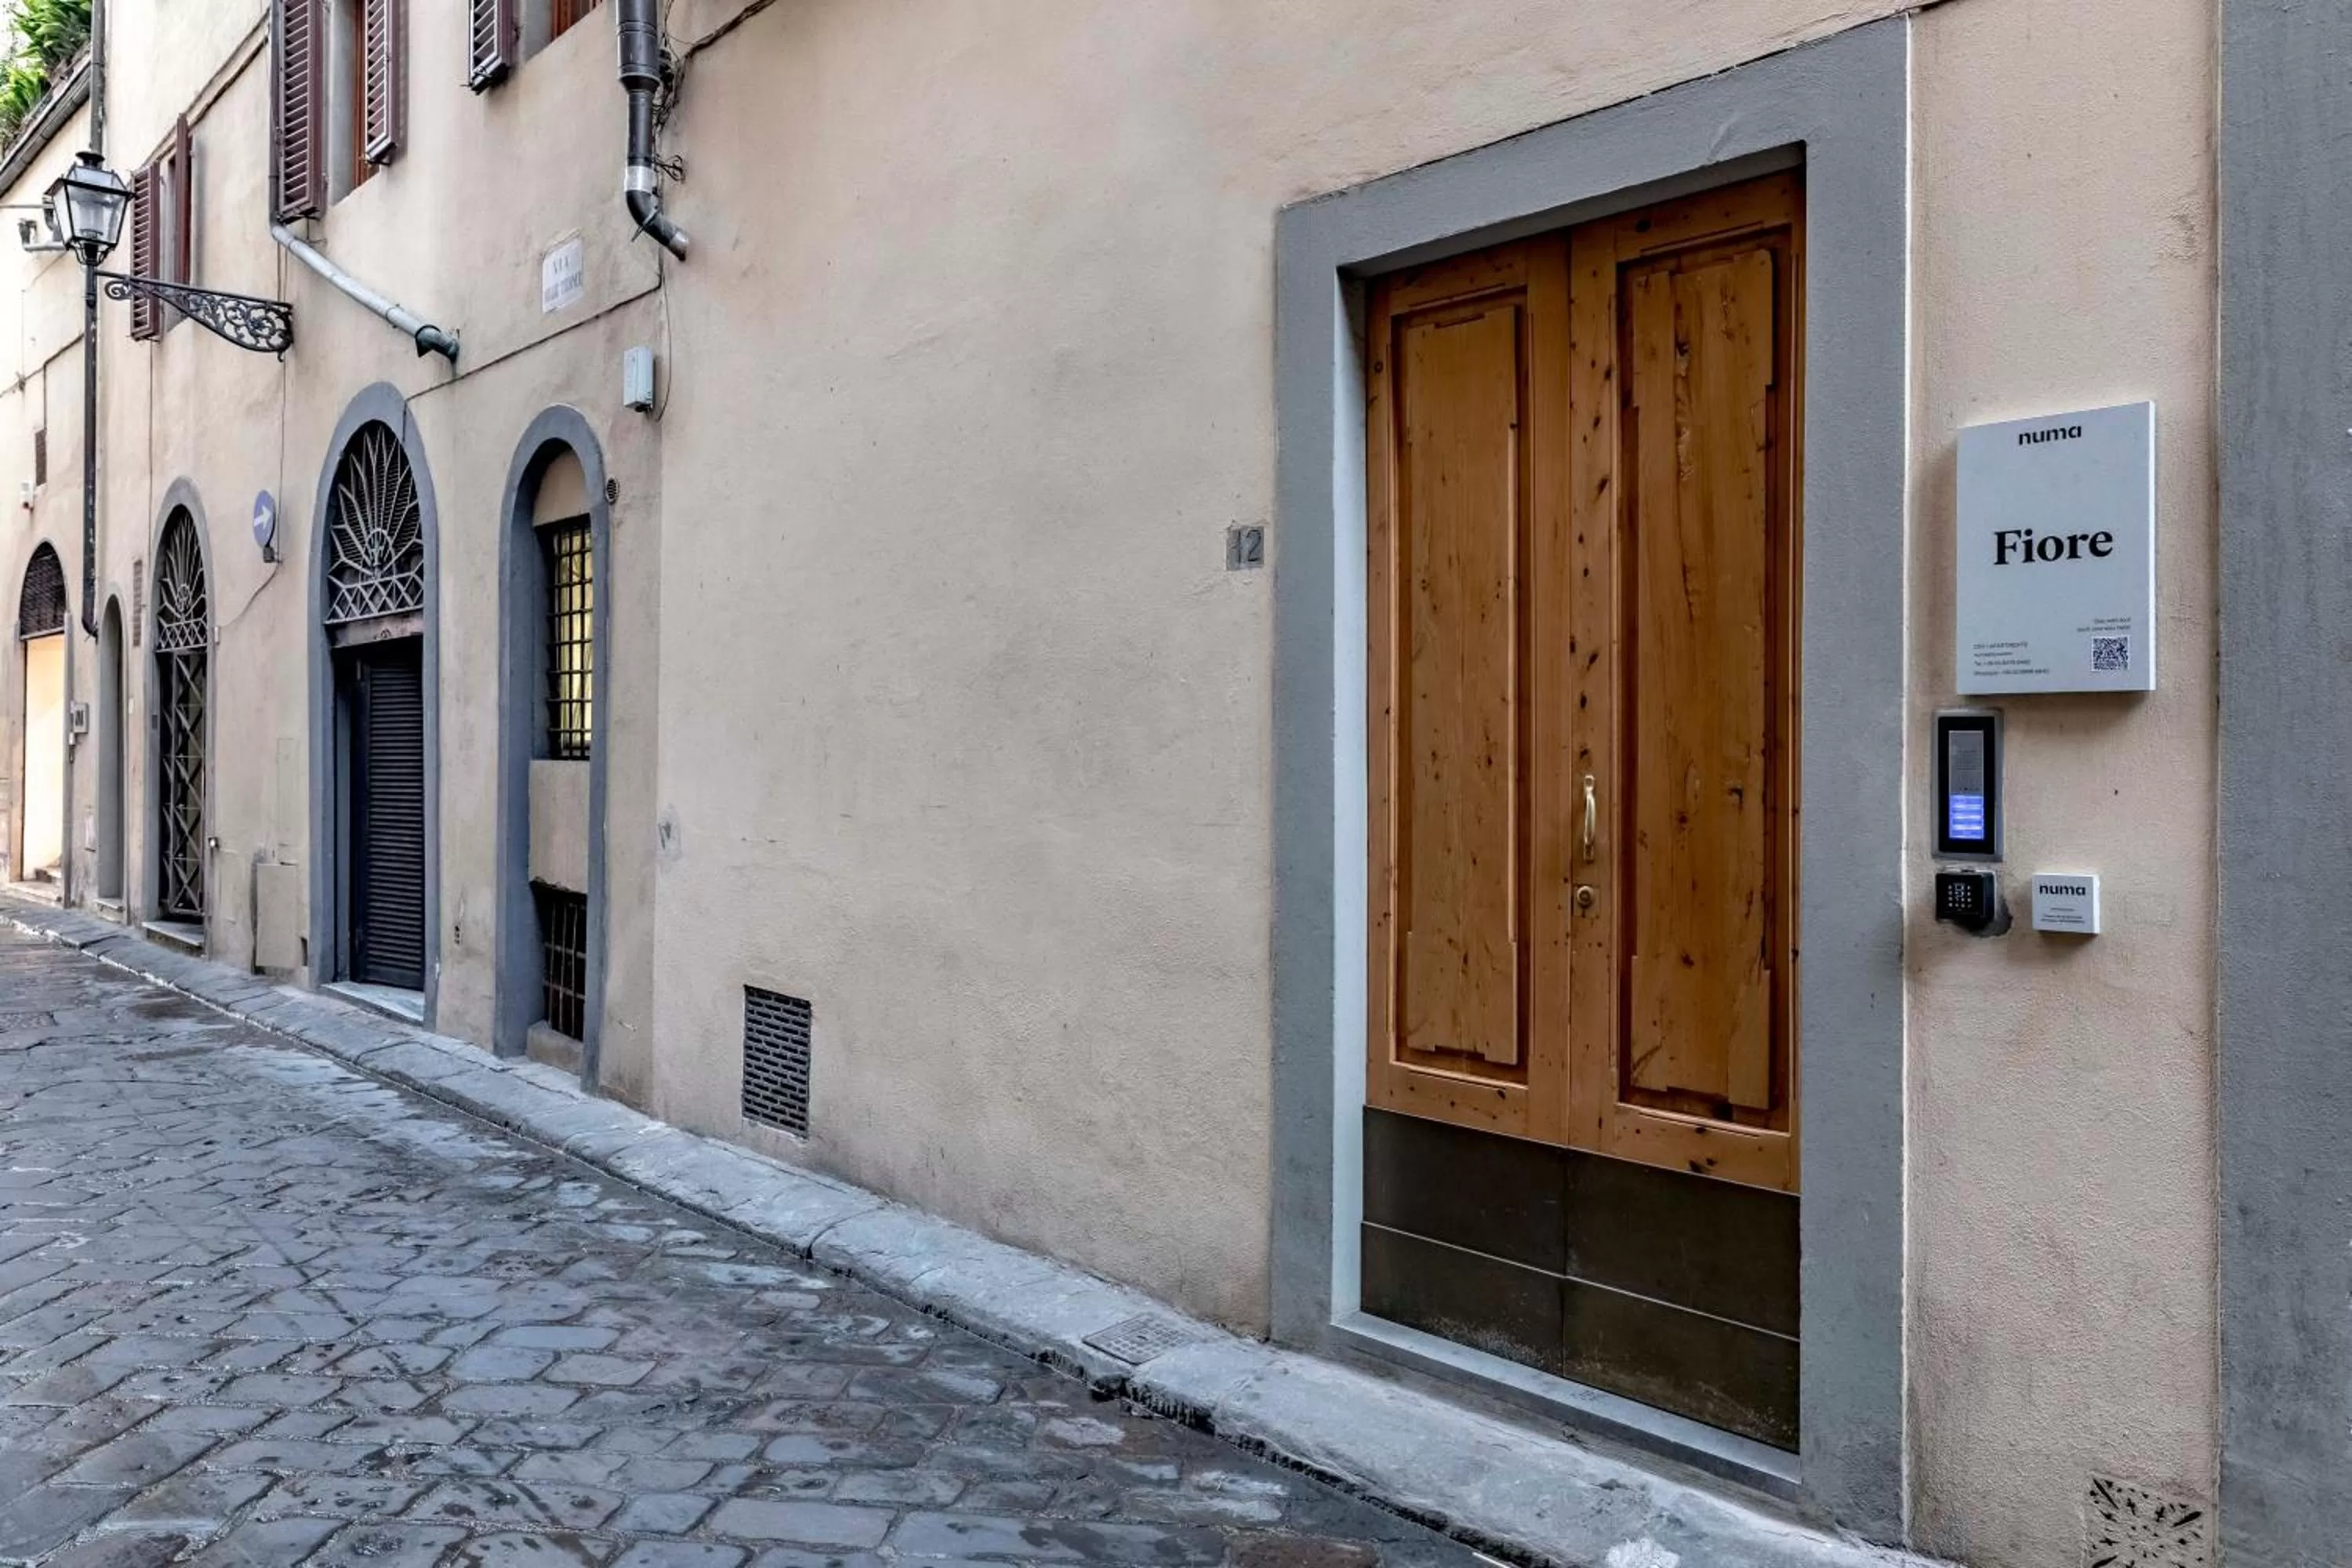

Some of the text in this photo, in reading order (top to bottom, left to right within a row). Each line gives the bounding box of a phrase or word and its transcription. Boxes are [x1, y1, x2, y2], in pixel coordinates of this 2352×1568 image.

[2019, 425, 2082, 445] numa
[1236, 528, 1261, 563] 12
[1994, 528, 2114, 565] Fiore
[2039, 884, 2086, 896] numa
